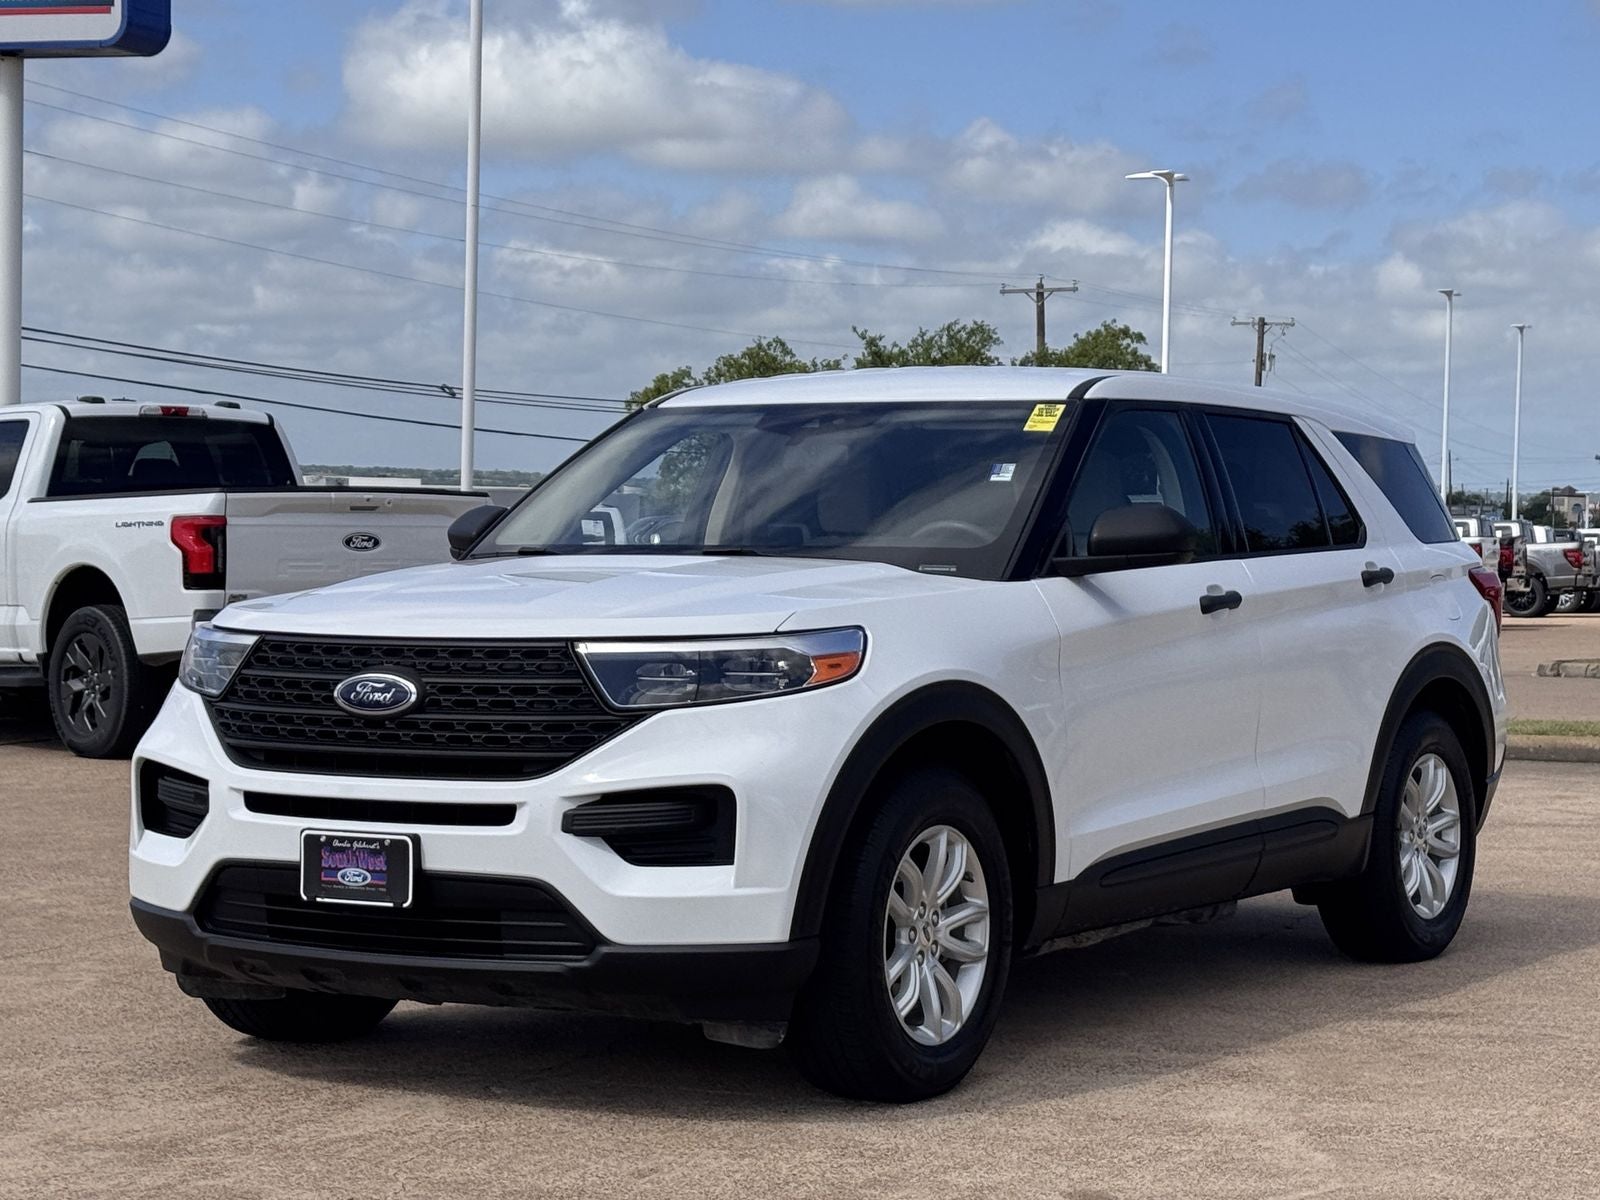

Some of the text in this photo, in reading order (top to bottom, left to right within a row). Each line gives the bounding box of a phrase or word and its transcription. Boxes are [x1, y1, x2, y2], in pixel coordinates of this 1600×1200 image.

[115, 520, 164, 528] LIGHTNING
[350, 536, 376, 549] Ford
[350, 681, 396, 704] Ford
[344, 871, 364, 883] Ford
